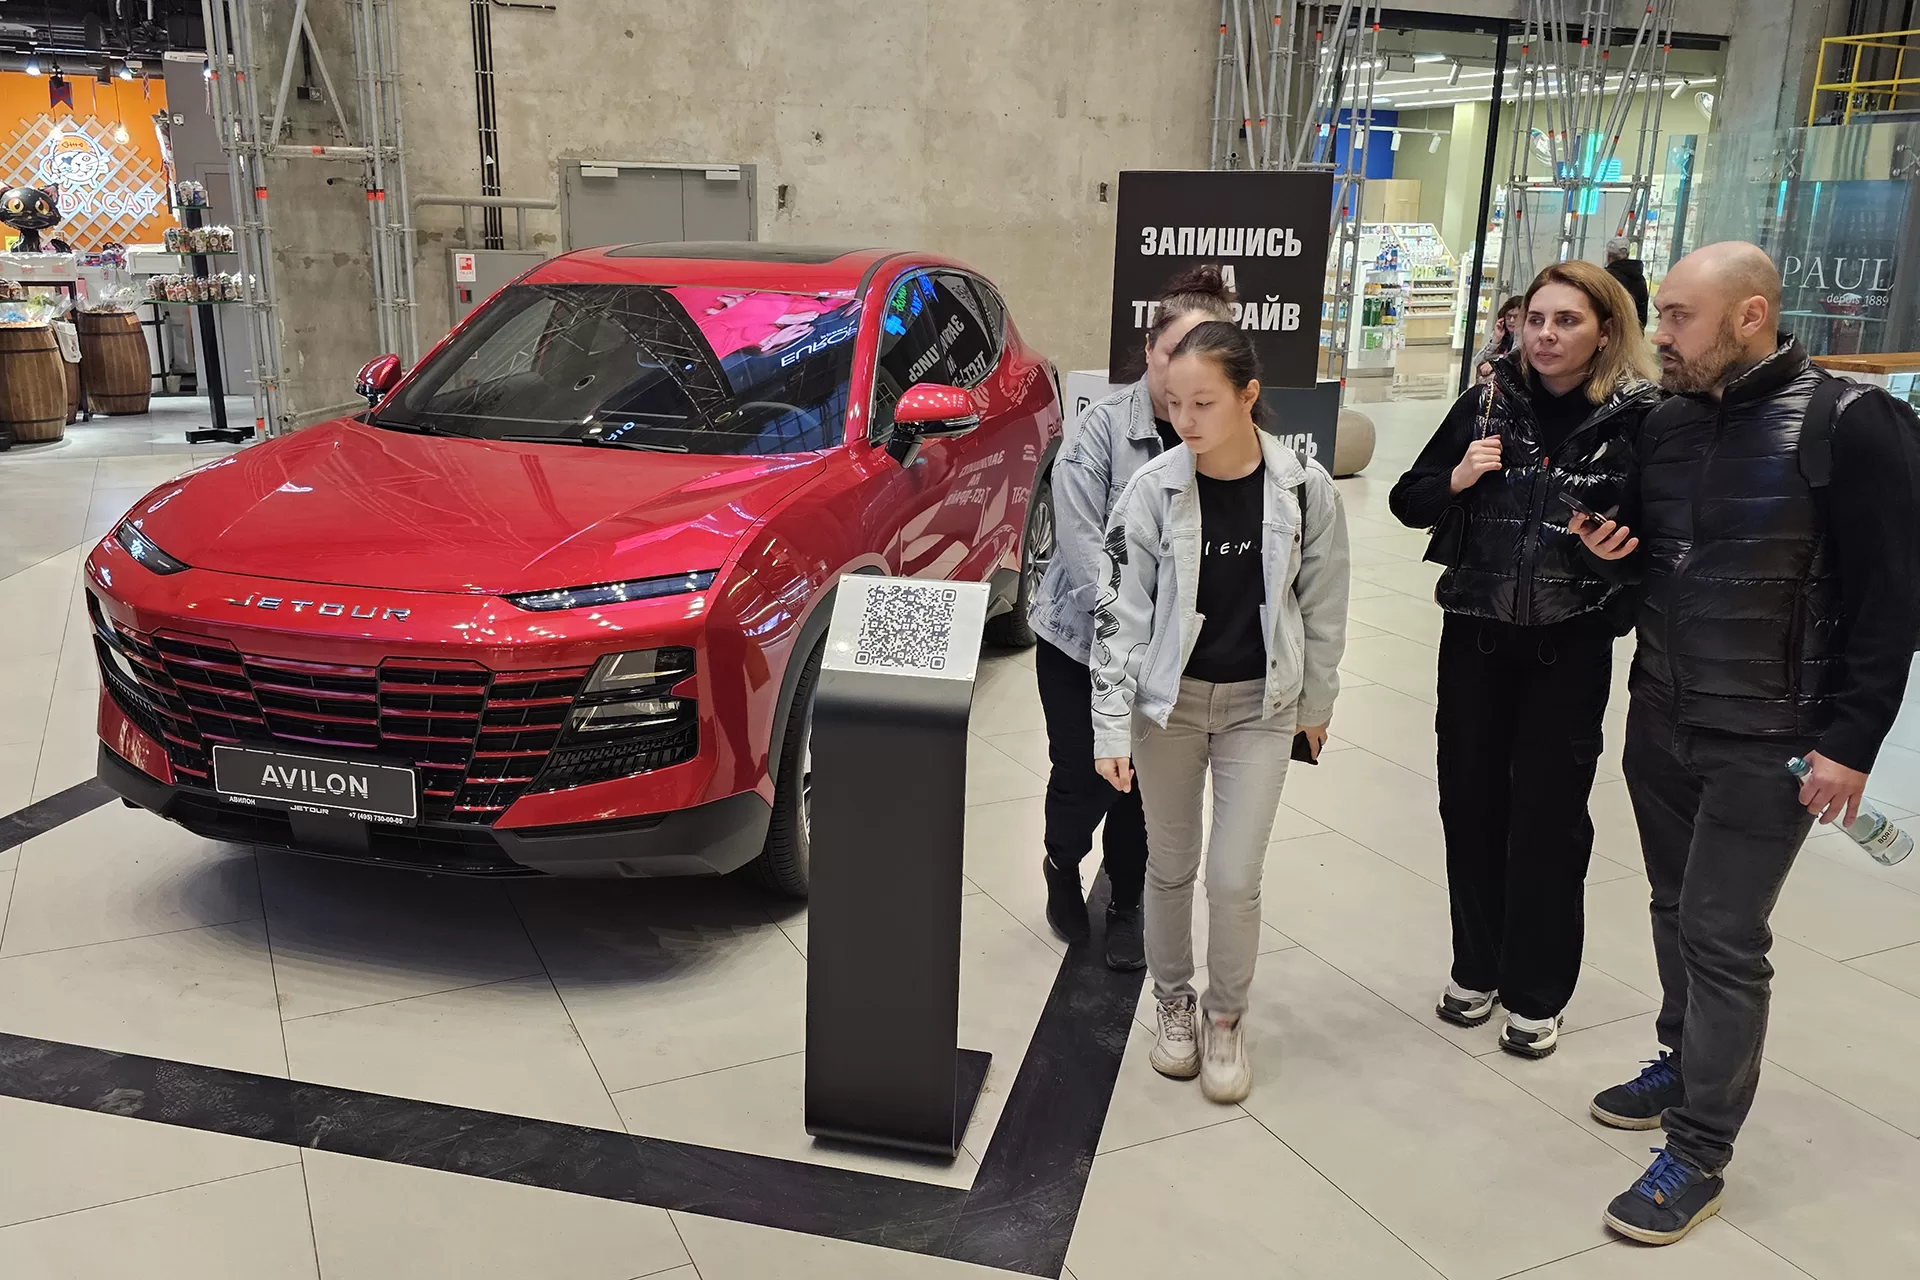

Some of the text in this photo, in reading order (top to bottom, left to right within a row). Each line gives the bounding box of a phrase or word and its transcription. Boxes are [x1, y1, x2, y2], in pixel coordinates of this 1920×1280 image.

[60, 193, 157, 213] DY CAT
[1140, 226, 1302, 257] ЗАПИШИСЬ
[1782, 255, 1895, 291] PAUL
[1827, 293, 1889, 307] depuis 1889
[1279, 432, 1318, 458] ИСЬ
[228, 594, 411, 622] JETOUR
[260, 764, 369, 799] AVILON
[228, 795, 256, 806] АВИЛОН
[289, 804, 330, 816] JETOUR
[348, 811, 357, 819] +7
[357, 812, 373, 822] (495)
